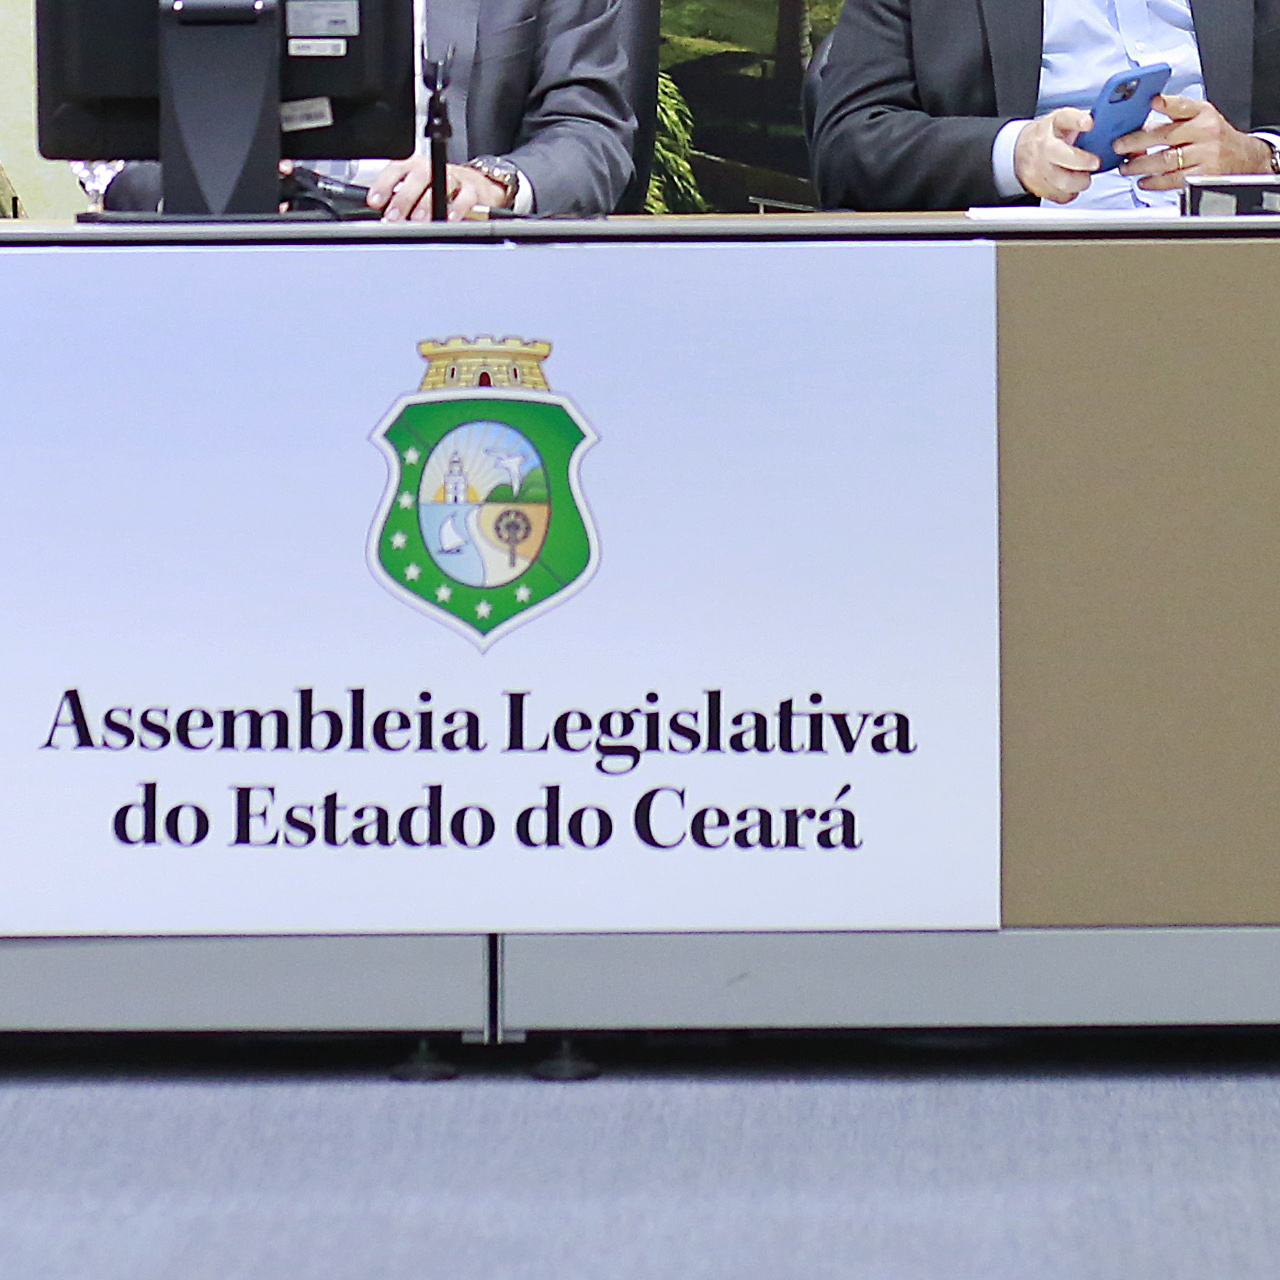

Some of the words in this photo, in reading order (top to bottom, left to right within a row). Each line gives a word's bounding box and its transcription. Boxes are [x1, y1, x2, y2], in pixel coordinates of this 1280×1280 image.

[42, 688, 487, 753] Assembleia
[506, 689, 917, 775] Legislativa
[113, 782, 210, 848] do
[232, 784, 496, 849] Estado
[515, 784, 613, 849] do
[633, 782, 863, 851] Ceará
